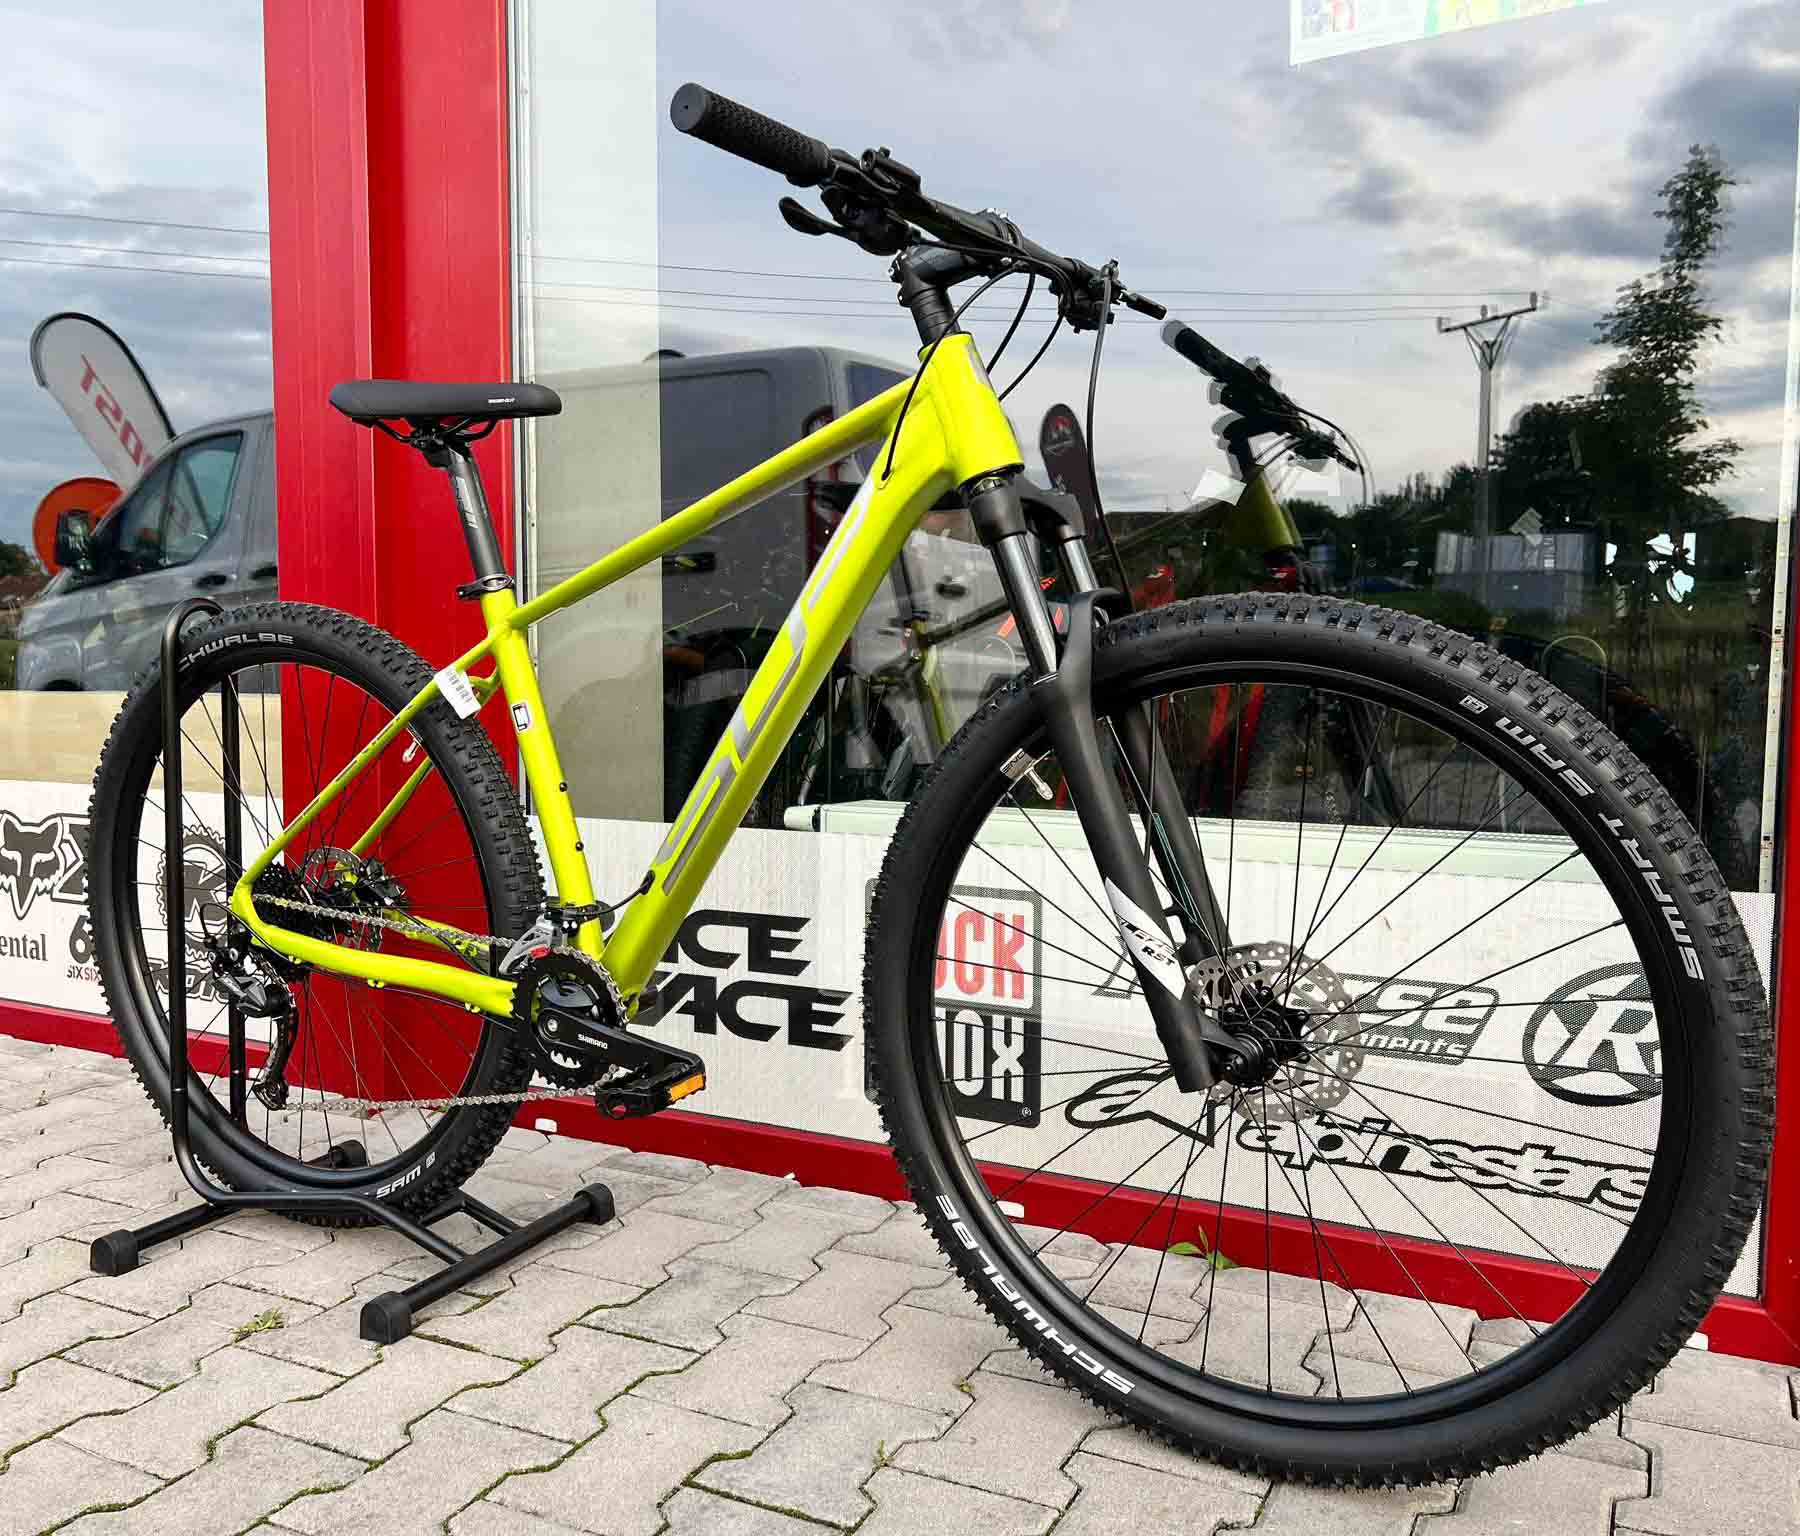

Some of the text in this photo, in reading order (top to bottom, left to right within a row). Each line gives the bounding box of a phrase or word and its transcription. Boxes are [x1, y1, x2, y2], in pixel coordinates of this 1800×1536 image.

[177, 631, 296, 673] CHWALBE
[1495, 716, 1705, 982] SMART SAM
[0, 933, 49, 962] ental
[1142, 946, 1176, 966] RST
[577, 1033, 608, 1050] SHIMANO
[376, 1164, 421, 1199] SAM
[935, 1193, 1136, 1396] SCHWALBE
